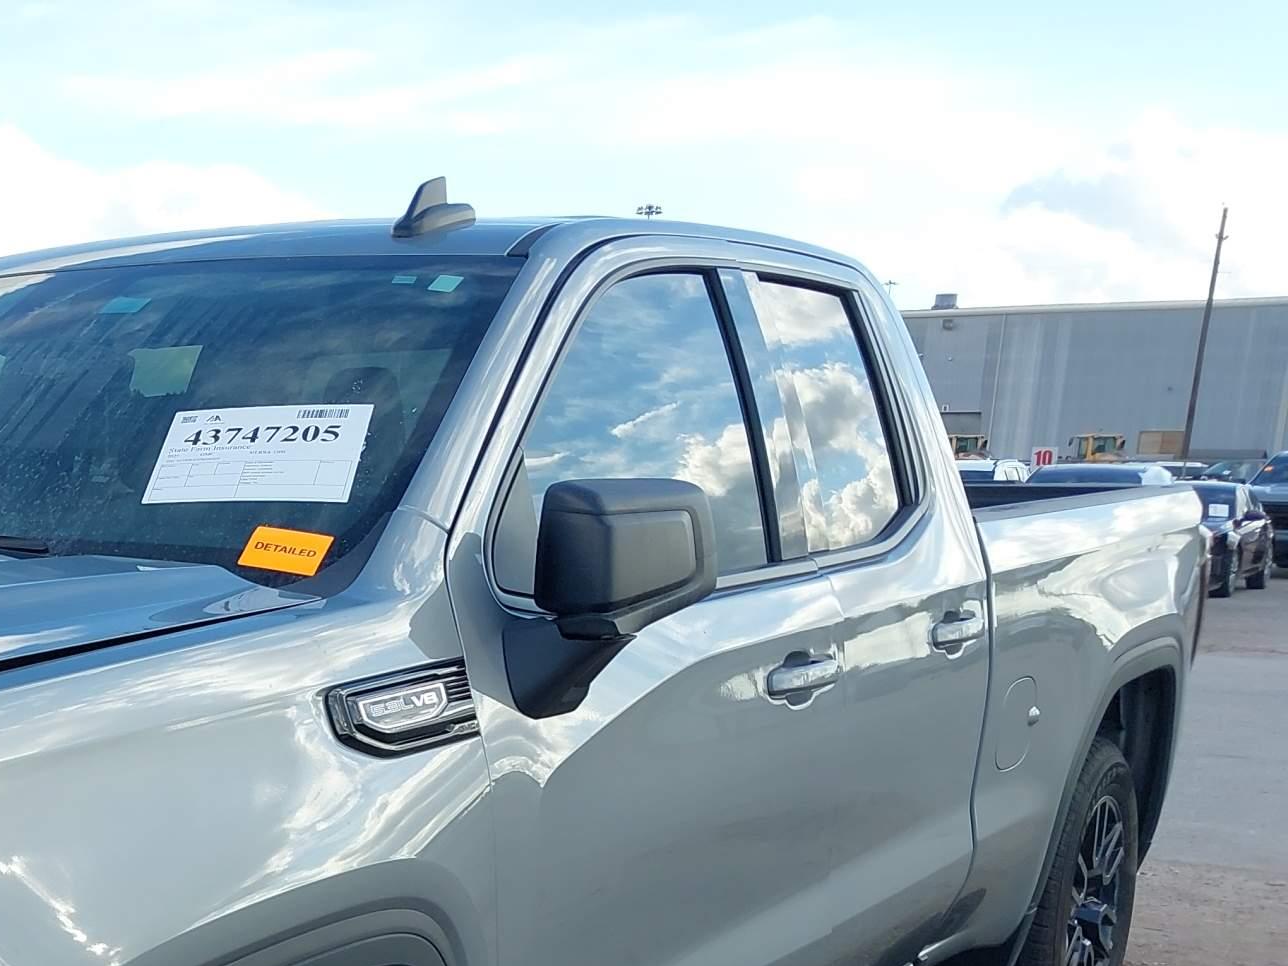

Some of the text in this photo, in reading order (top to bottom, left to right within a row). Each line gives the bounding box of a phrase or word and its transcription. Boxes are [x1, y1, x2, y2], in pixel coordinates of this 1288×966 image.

[183, 425, 343, 446] 43747205
[1033, 450, 1053, 466] 10
[253, 541, 317, 558] DETAILED
